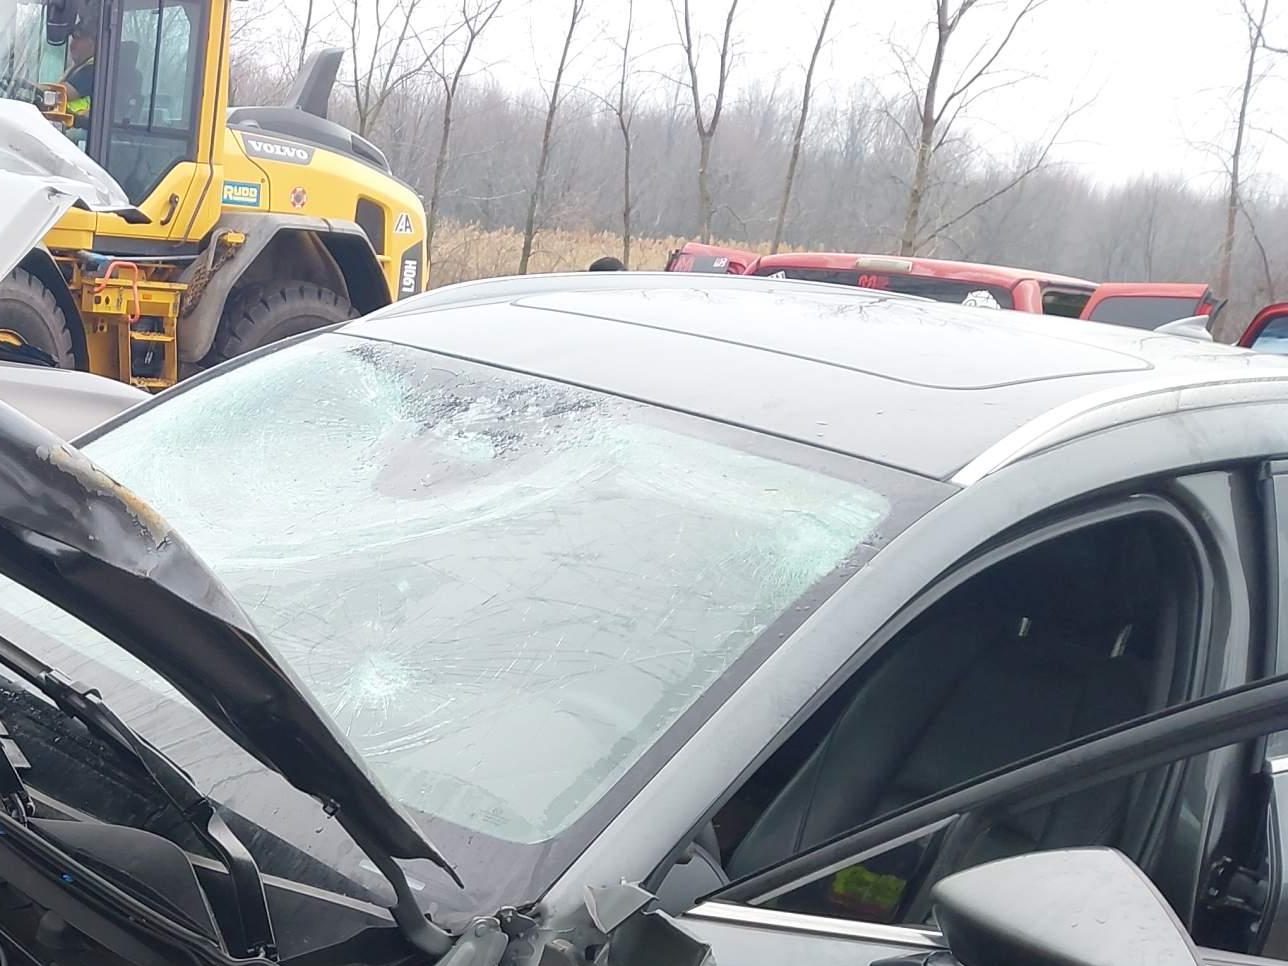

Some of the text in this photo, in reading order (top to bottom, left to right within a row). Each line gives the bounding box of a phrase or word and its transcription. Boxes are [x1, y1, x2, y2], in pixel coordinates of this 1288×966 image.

[247, 139, 309, 160] VOLVO
[223, 185, 258, 201] RUDD
[401, 259, 418, 293] L90H
